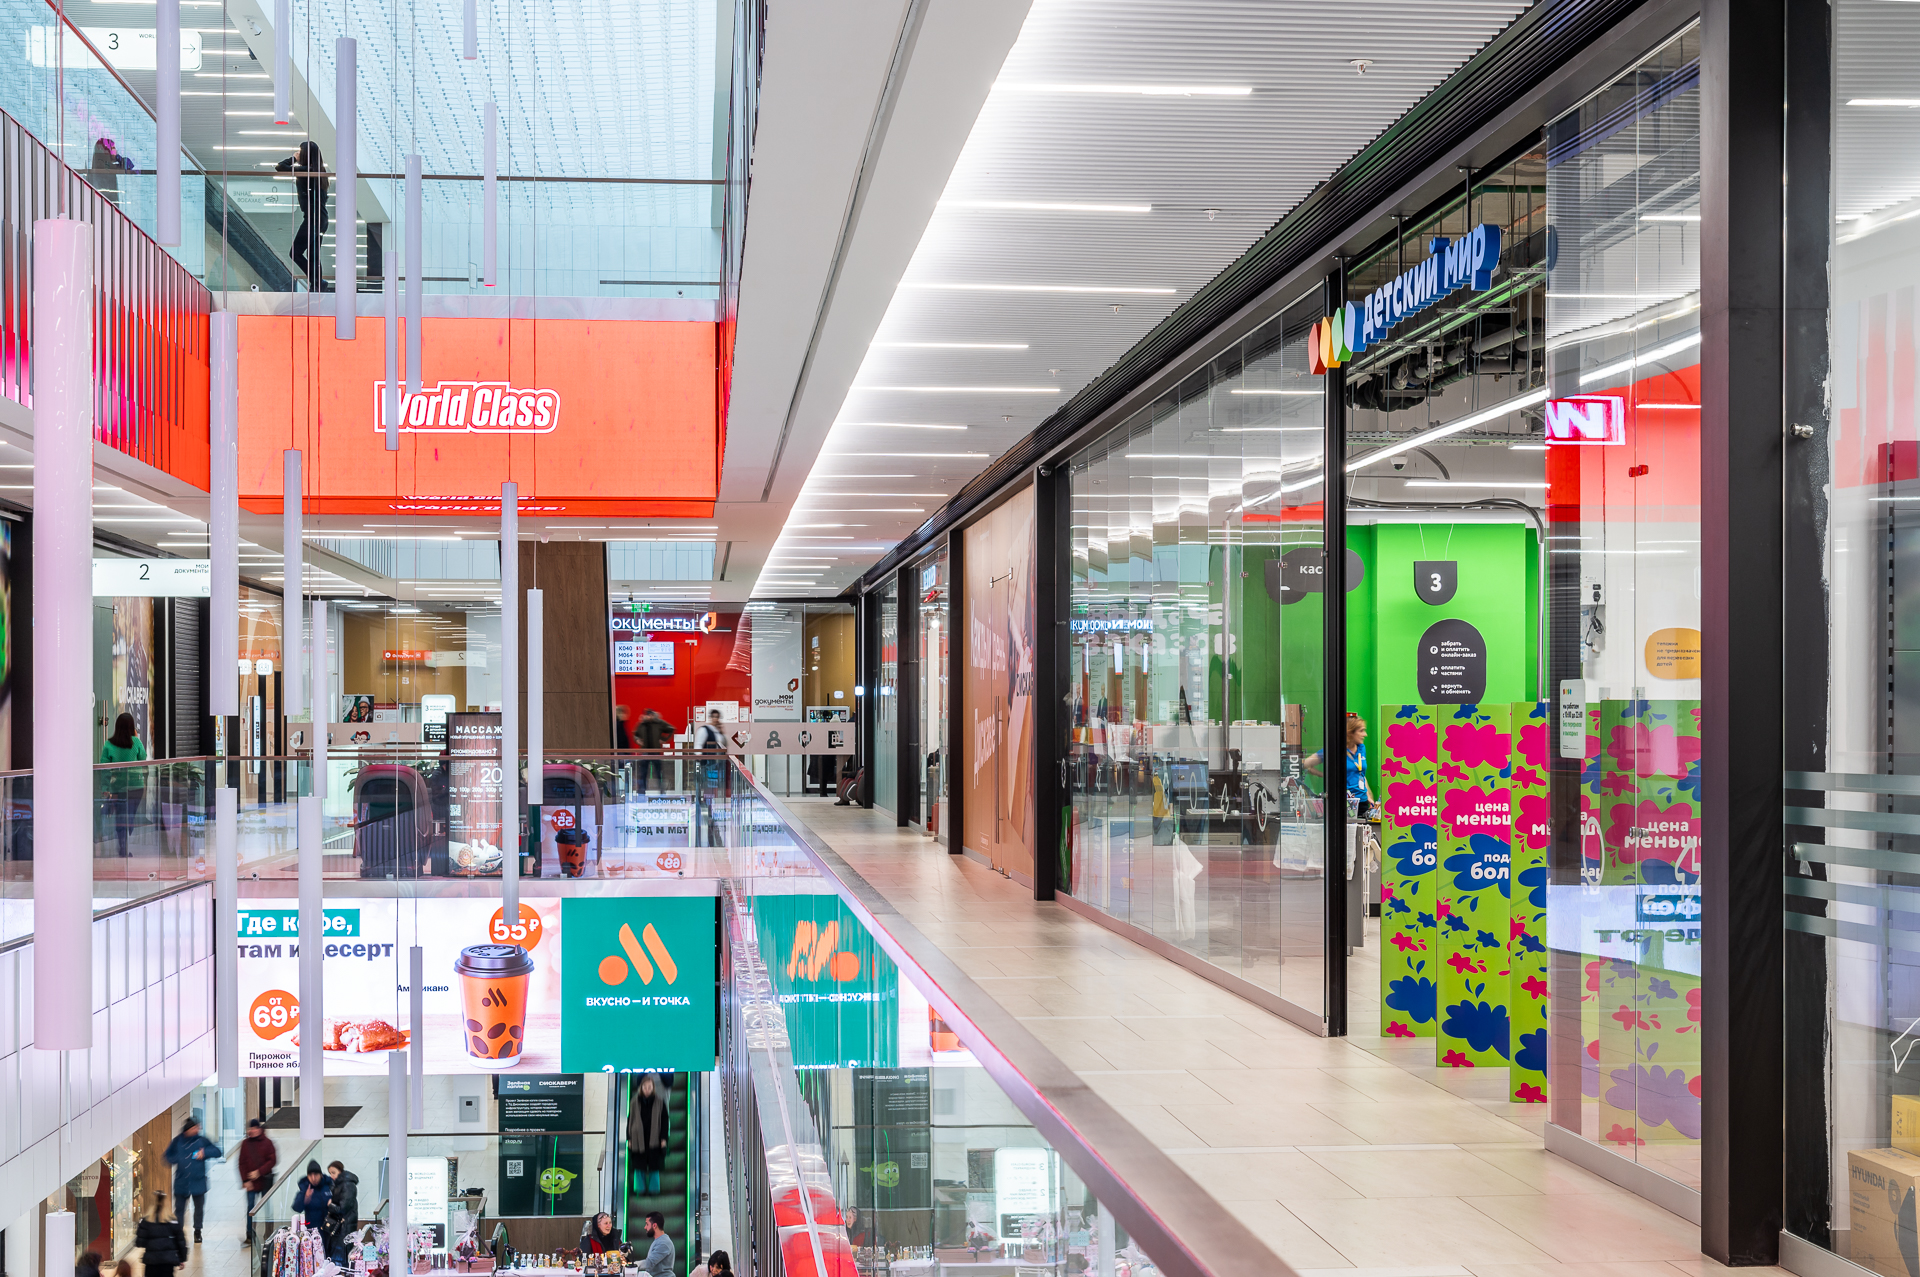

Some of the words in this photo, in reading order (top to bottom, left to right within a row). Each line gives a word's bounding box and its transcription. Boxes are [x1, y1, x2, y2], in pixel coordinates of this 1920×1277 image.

[108, 33, 119, 50] 3
[1362, 236, 1446, 344] детский
[1443, 223, 1490, 291] мир
[471, 388, 553, 426] Class
[139, 563, 150, 580] 2
[1299, 565, 1323, 575] кас
[1430, 573, 1442, 592] 3
[755, 698, 794, 706] документы
[455, 725, 503, 734] МАССАЖ
[1475, 802, 1510, 813] цена
[1648, 821, 1690, 832] цена
[237, 912, 277, 935] Где
[237, 944, 282, 958] там
[322, 943, 394, 961] есерт
[397, 984, 449, 993] Амикано
[269, 997, 282, 1005] от
[586, 997, 631, 1006] ВКУСНО
[642, 997, 651, 1005] И
[653, 996, 690, 1006] ТОЧКА
[249, 1052, 292, 1061] Пирожок
[249, 1061, 283, 1070] Пряное
[408, 1172, 413, 1180] 3
[1852, 1164, 1886, 1191] HYUNDAI
